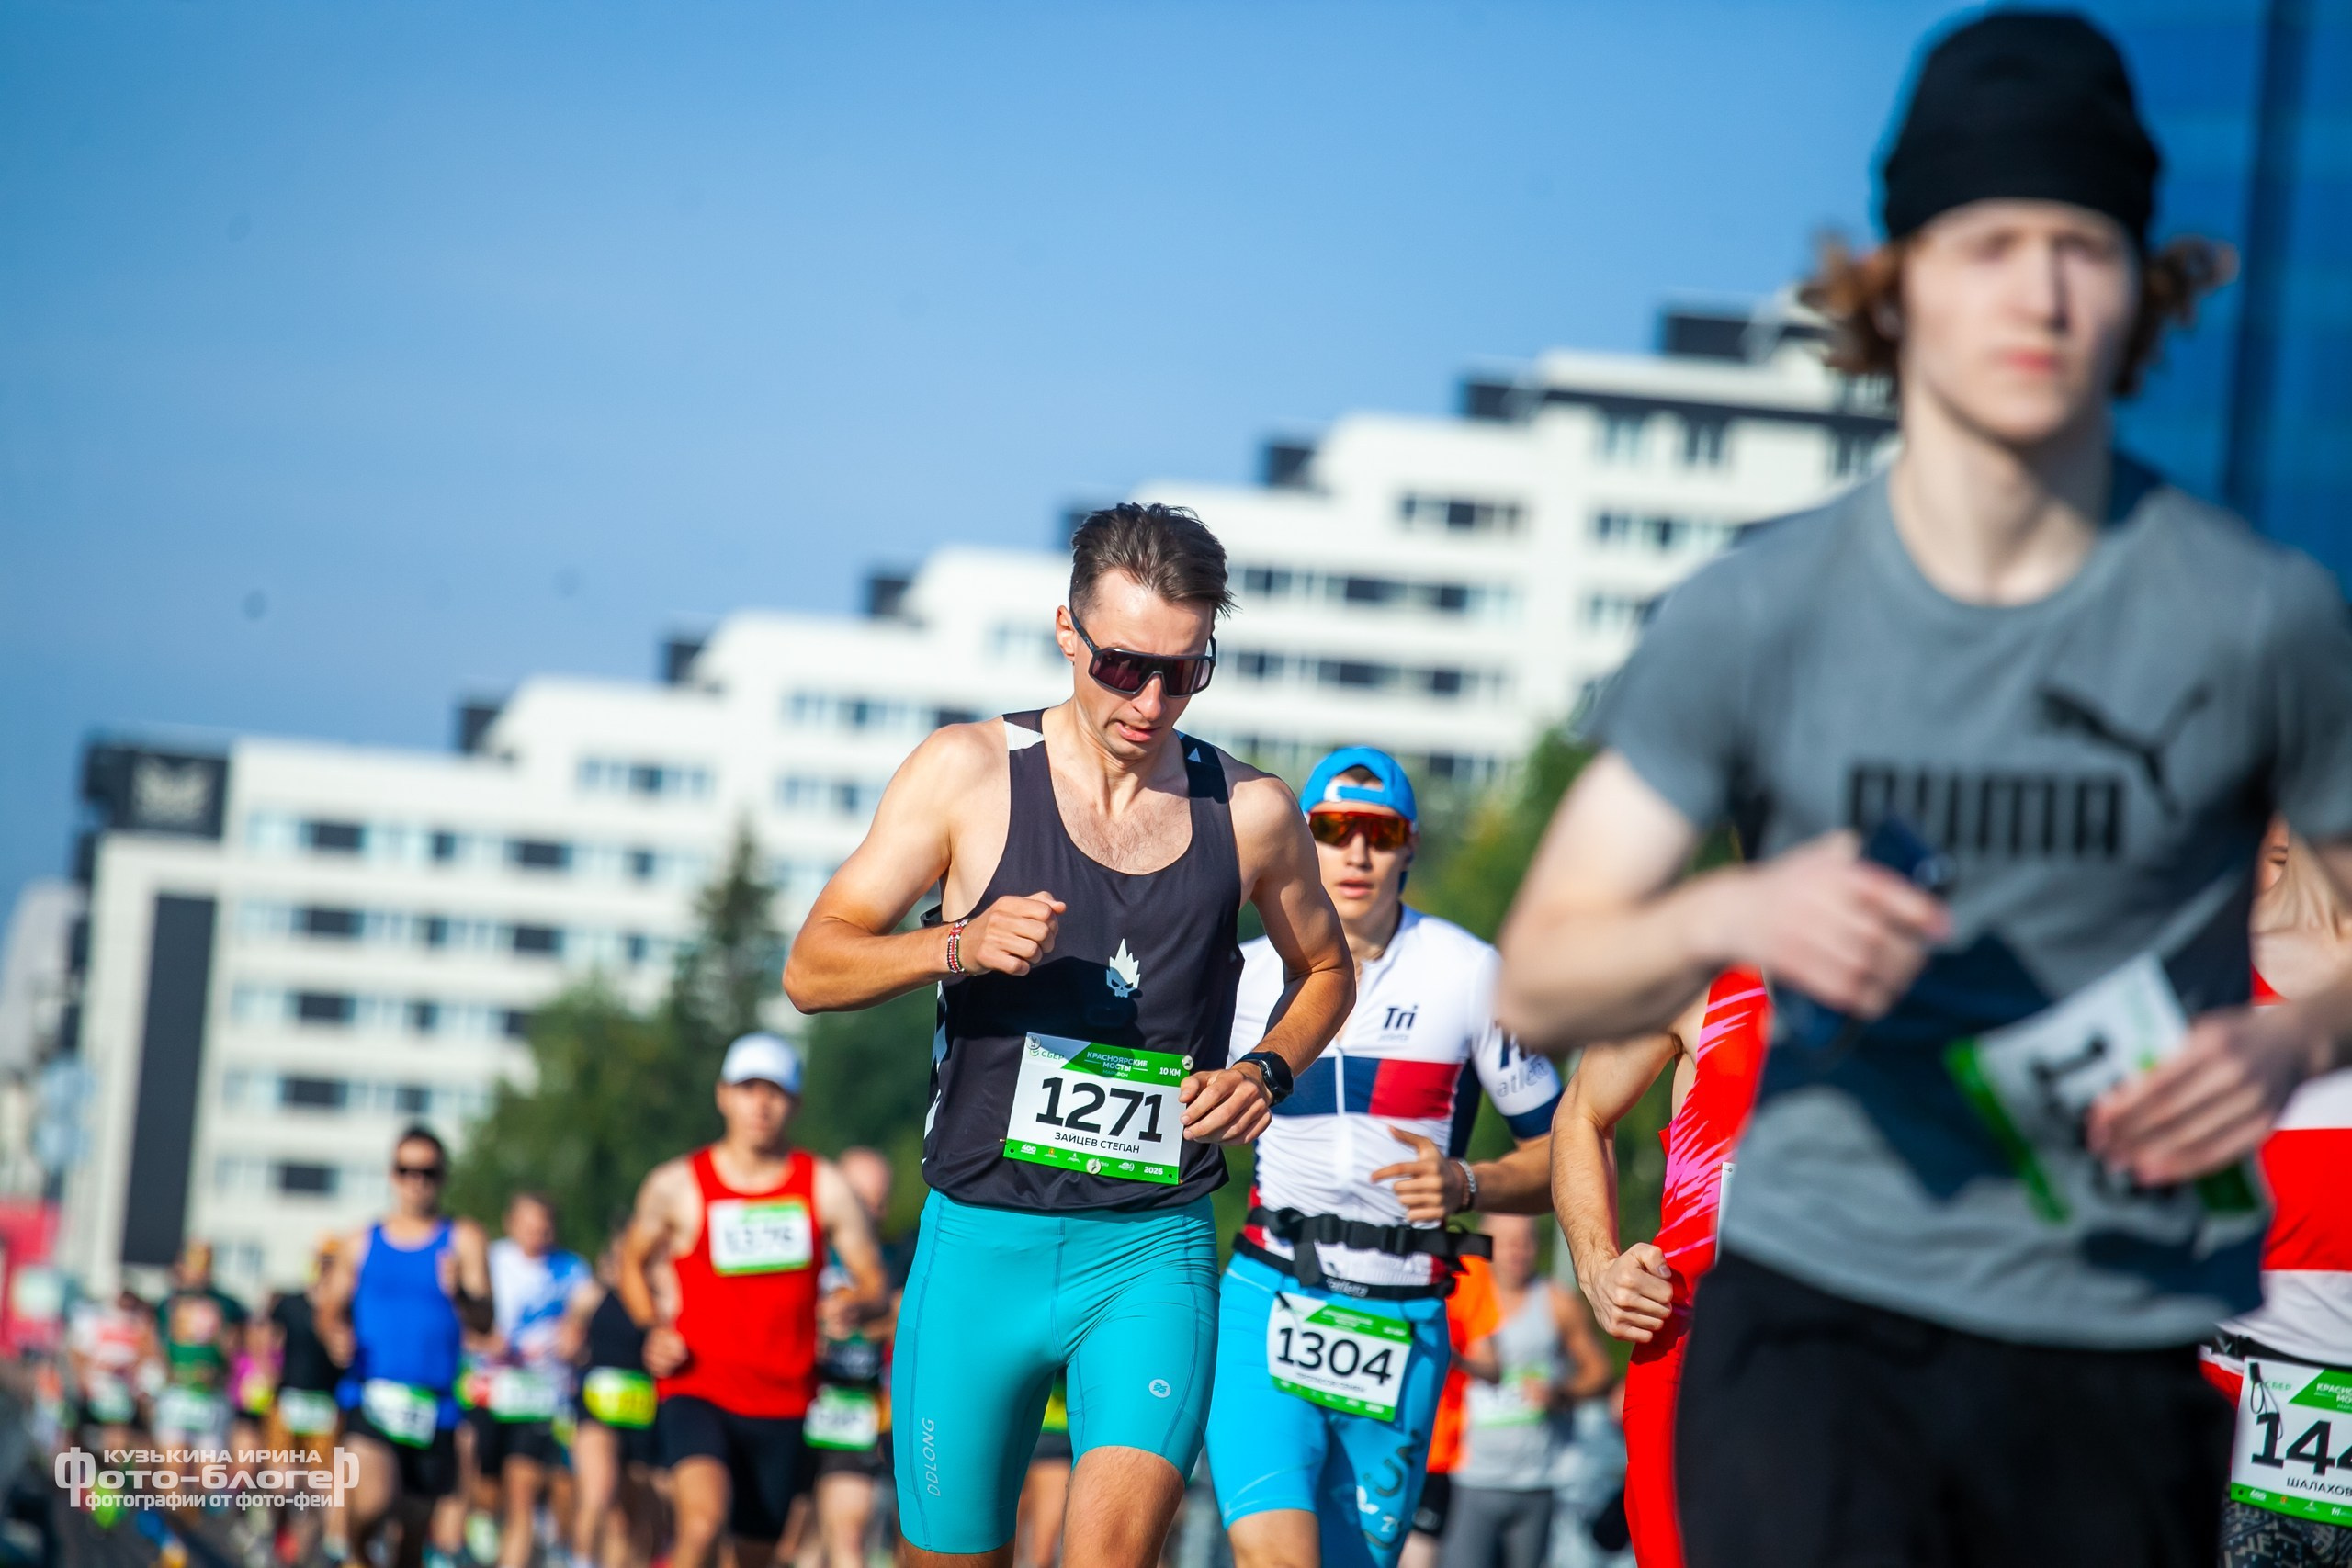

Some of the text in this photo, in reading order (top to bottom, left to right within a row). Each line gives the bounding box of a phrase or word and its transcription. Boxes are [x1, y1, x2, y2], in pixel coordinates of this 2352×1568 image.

[1385, 1005, 1418, 1028] Tri
[1041, 1052, 1065, 1061] СБЕР
[1087, 1051, 1148, 1067] КРАСНОЯРСКИЕ
[1102, 1061, 1132, 1072] МОСТЫ
[1159, 1066, 1168, 1076] 10
[1035, 1077, 1163, 1143] 1271
[1055, 1131, 1140, 1154] ЗАЙЦЕВ СТЕПАН
[1143, 1166, 1164, 1175] 2026
[1277, 1327, 1394, 1385] 1304
